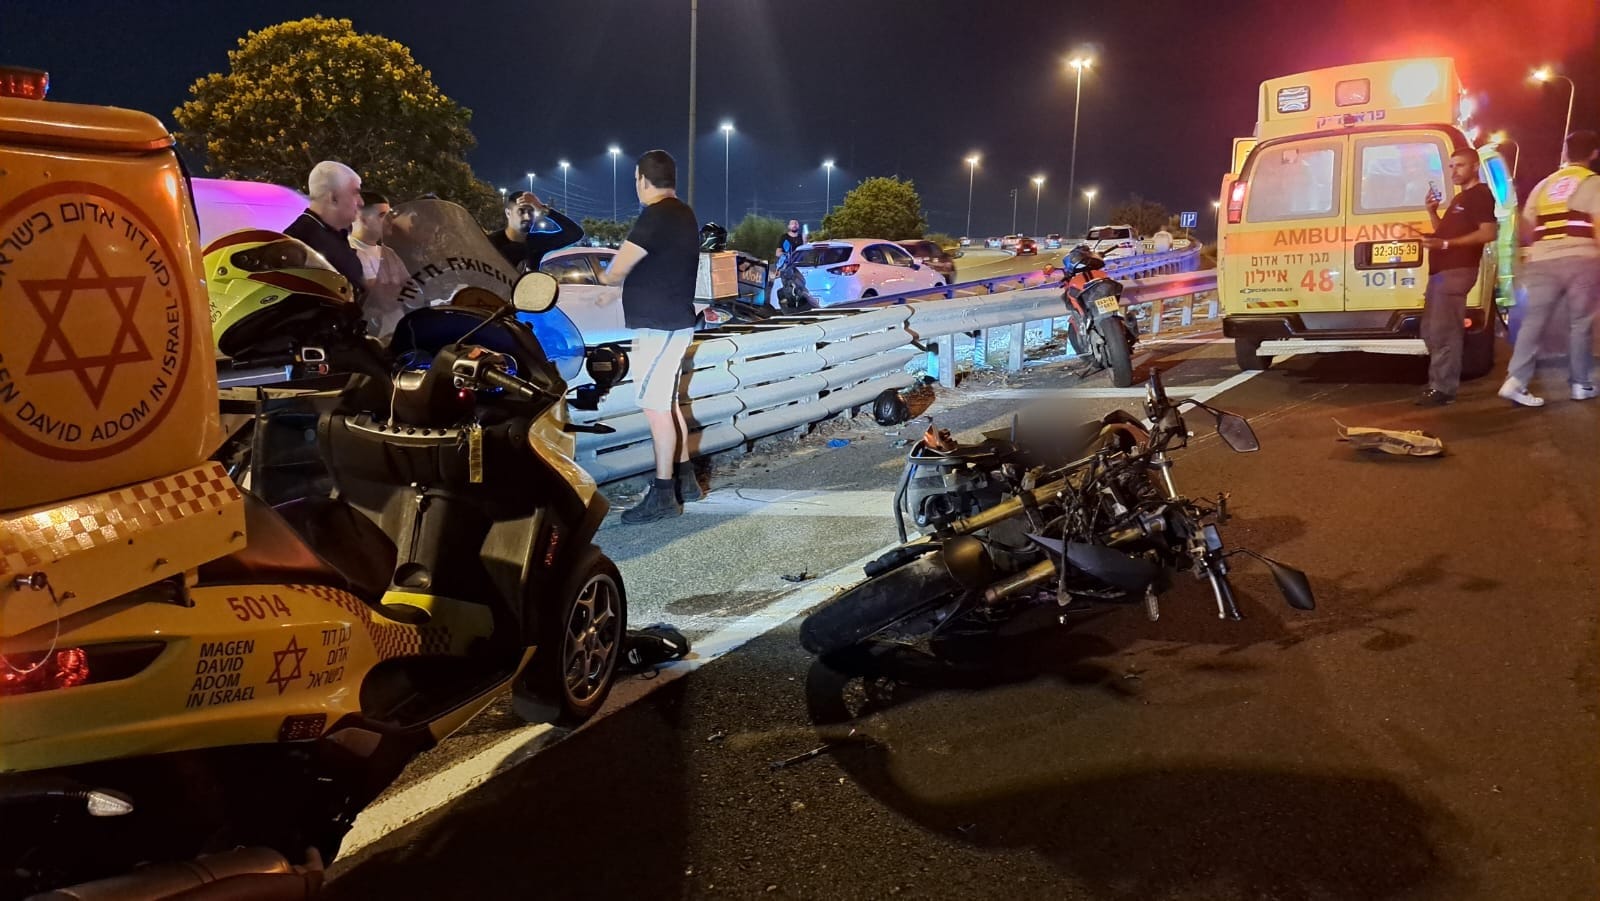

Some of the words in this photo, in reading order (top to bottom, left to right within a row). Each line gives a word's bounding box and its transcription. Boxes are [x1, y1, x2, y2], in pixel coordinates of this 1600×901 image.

[1316, 109, 1385, 129] פראדיק
[60, 202, 115, 229] אדום
[121, 216, 149, 251] דוד
[1274, 221, 1424, 247] AMBULANCE
[1251, 254, 1278, 267] אדום
[1285, 253, 1303, 265] דוד
[1310, 252, 1330, 265] מגן
[1245, 269, 1288, 288] איילון
[1300, 268, 1334, 292] 48
[16, 401, 82, 442] DAVID
[91, 399, 150, 442] ADOM
[149, 377, 168, 402] IN
[161, 299, 180, 376] ISRAEL
[226, 594, 292, 621] 5014
[321, 629, 337, 647] דוד
[200, 639, 255, 658] MAGEN
[327, 647, 349, 666] אדום
[195, 656, 244, 675] DAVID
[191, 672, 241, 692] ADOM
[306, 666, 344, 689] בישראל
[186, 691, 205, 708] IN
[208, 686, 255, 706] ISRAEL
